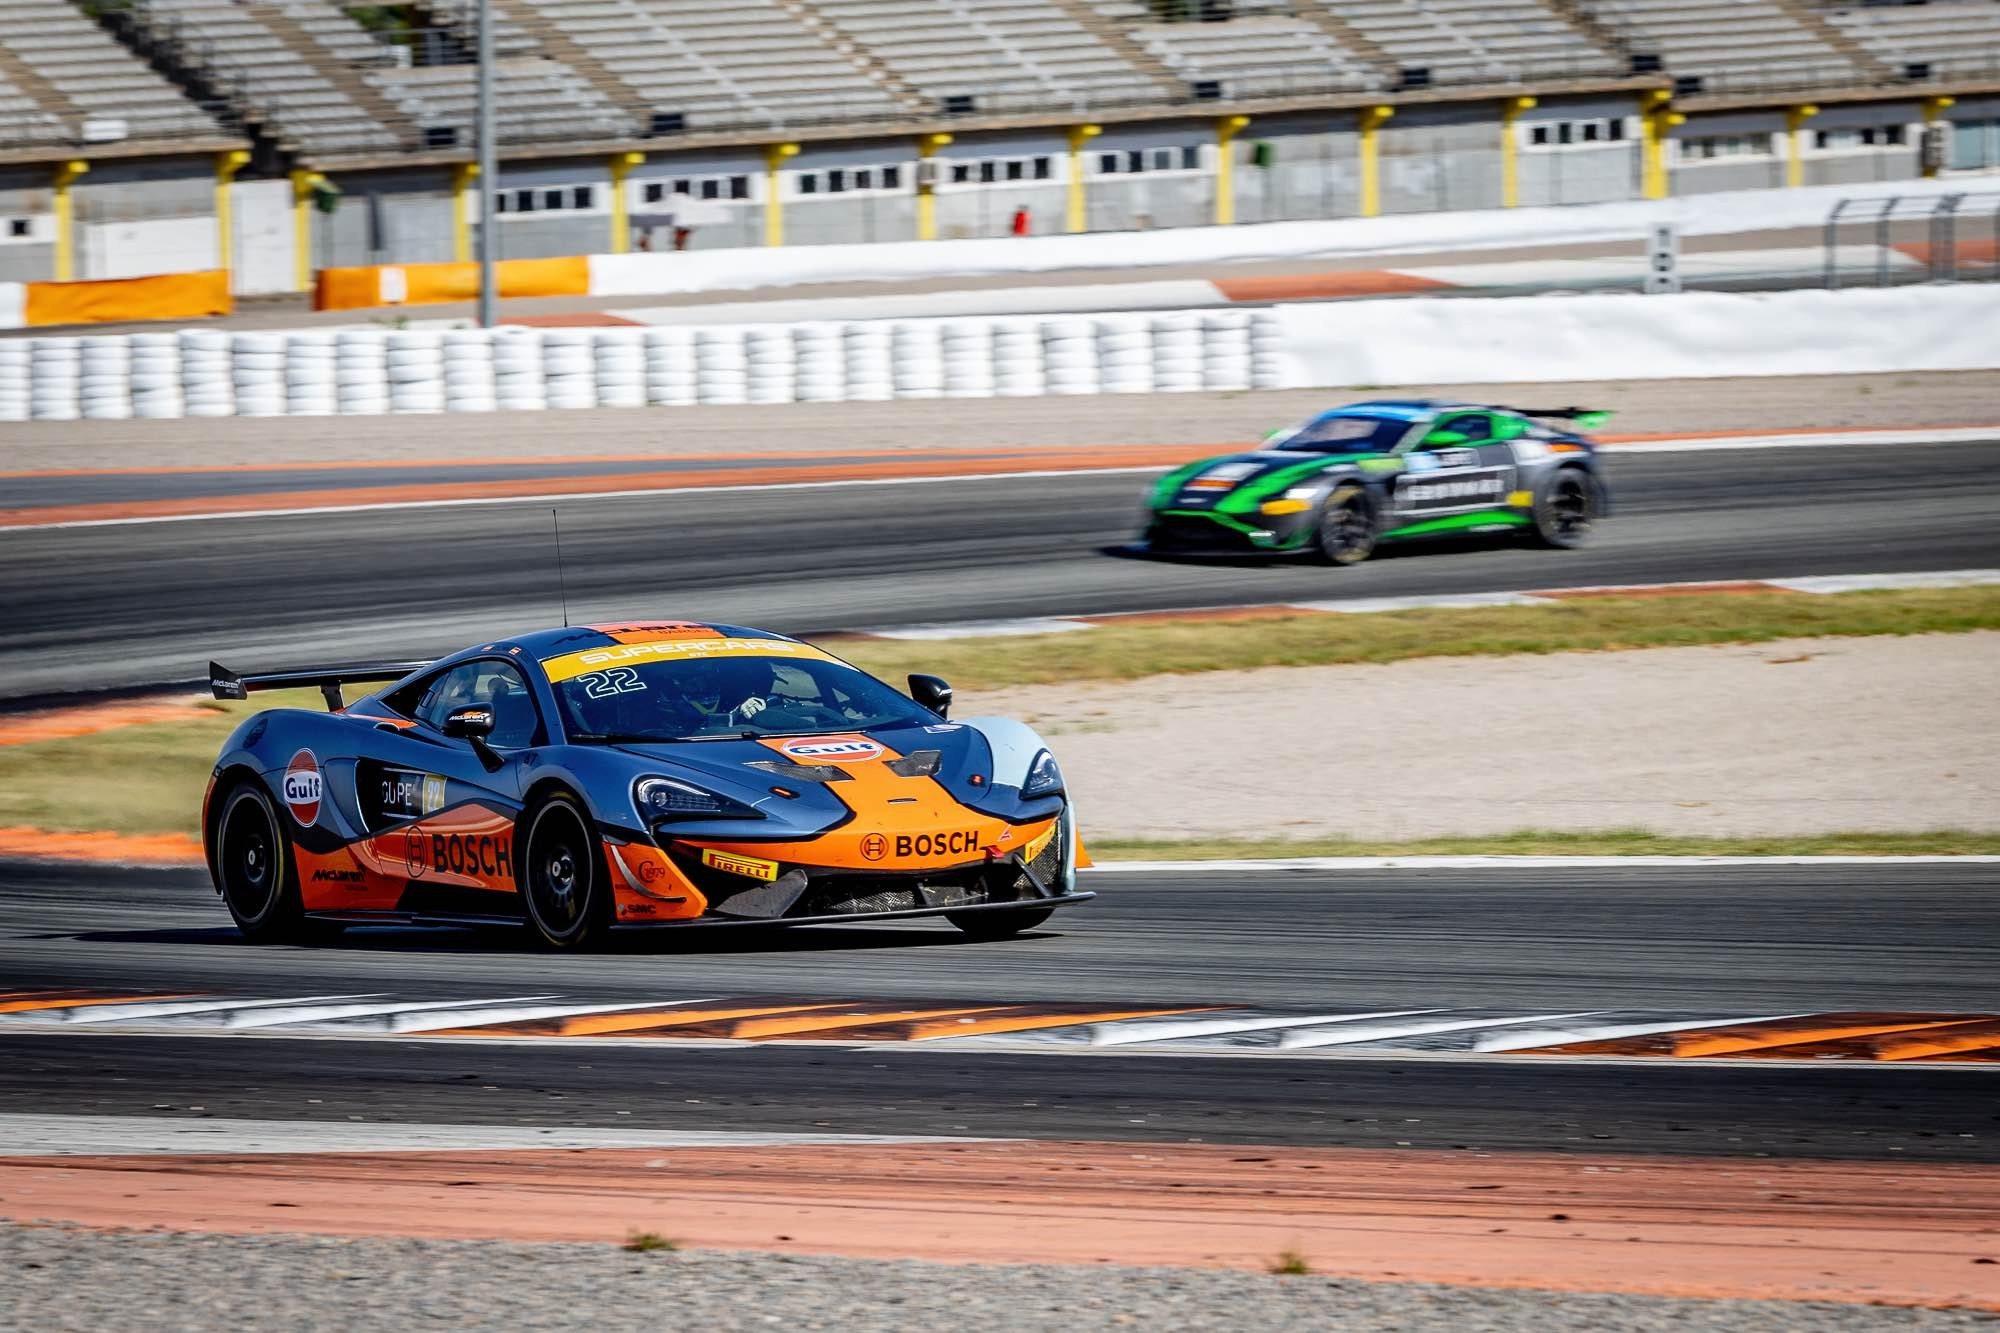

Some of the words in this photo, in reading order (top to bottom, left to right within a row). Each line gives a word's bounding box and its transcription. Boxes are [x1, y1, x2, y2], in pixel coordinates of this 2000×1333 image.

[579, 641, 795, 664] SUPERCARS
[576, 666, 648, 699] 22
[789, 743, 873, 754] Gulf
[285, 777, 319, 799] Gulf
[432, 833, 513, 877] BOSCH
[895, 830, 979, 857] BOSCH
[709, 852, 771, 879] PIRELLI
